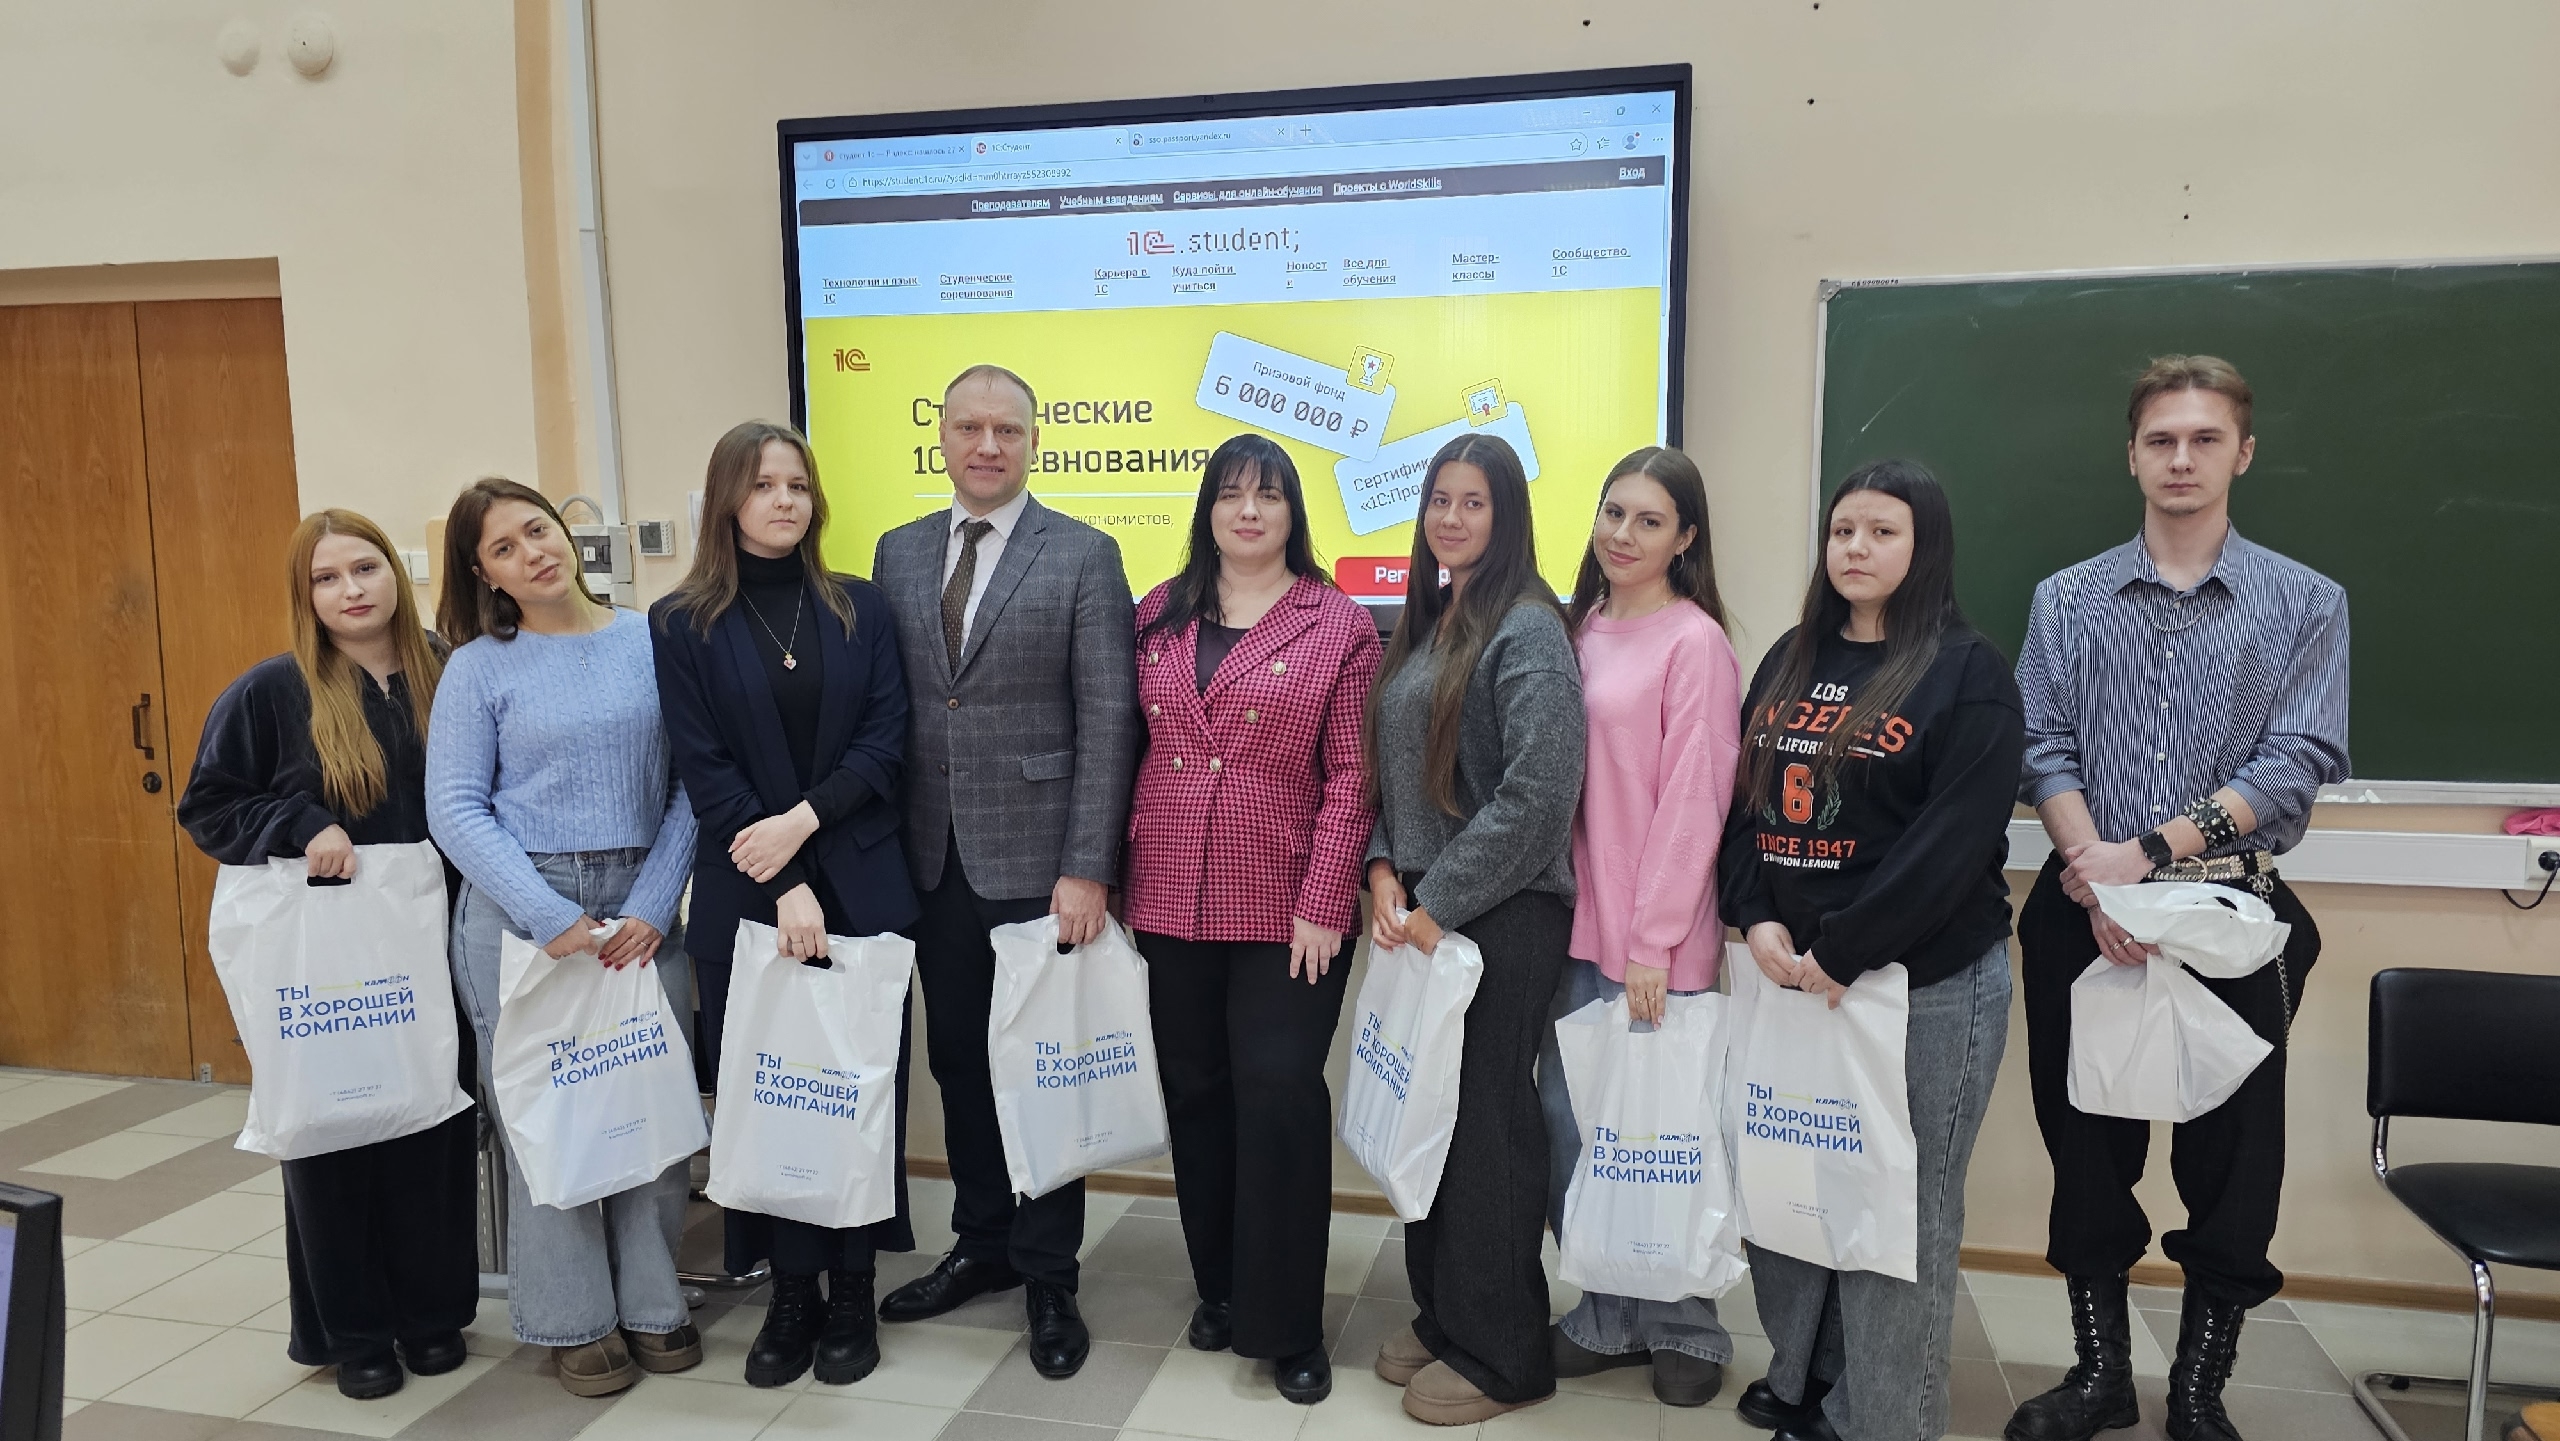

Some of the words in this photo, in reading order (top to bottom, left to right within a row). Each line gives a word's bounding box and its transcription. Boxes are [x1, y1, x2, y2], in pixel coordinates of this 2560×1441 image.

[1619, 167, 1646, 180] Вход
[1173, 190, 1216, 203] Сервисы
[1219, 188, 1236, 202] для
[1239, 185, 1323, 199] онлайн-обучения
[1333, 182, 1378, 195] Проекты
[1389, 176, 1442, 191] WorldSkills
[972, 198, 1051, 212] Преподавателям
[1060, 195, 1103, 208] Учебным
[1105, 193, 1164, 206] заведениям
[1452, 252, 1500, 265] Мастер-
[1552, 247, 1628, 260] Сообщество
[1172, 266, 1198, 277] Куда
[1201, 264, 1234, 275] пойти
[1287, 260, 1328, 271] Новост
[1343, 258, 1364, 269] Все
[1366, 258, 1388, 269] для
[1552, 265, 1568, 277] 1С
[823, 278, 880, 289] Технологии
[891, 276, 918, 287] язык
[940, 273, 1013, 285] Студенческие
[1094, 268, 1138, 280] Карьера
[1343, 274, 1396, 287] обучения
[1452, 269, 1495, 281] классы
[940, 289, 1013, 300] соревнования
[1095, 284, 1109, 295] 1С
[1172, 282, 1217, 293] учиться
[823, 293, 836, 304] 1С
[1253, 361, 1312, 389] Призовой
[1314, 381, 1347, 402] фонд
[912, 397, 1153, 427] Стческие
[1215, 374, 1232, 396] 6
[1238, 382, 1287, 413] 000
[1294, 401, 1343, 432] 000
[913, 446, 1210, 475] 1Свнования
[1353, 456, 1434, 492] Сертифик
[1360, 484, 1423, 512] «1С:Про
[1811, 682, 1849, 702] LOS
[1783, 762, 1815, 825] 6
[1807, 839, 1856, 858] 1947
[1802, 858, 1841, 870] LEAGUE
[276, 985, 310, 1002] ТЫ
[279, 1006, 293, 1021] В
[300, 986, 414, 1019] ХОРОШЕЙ
[280, 1007, 416, 1040] КОМПАНИИ
[1368, 1011, 1382, 1034] ТЫ
[1361, 1027, 1371, 1042] В
[547, 1036, 576, 1056] ТЫ
[551, 1058, 563, 1072] В
[568, 1020, 664, 1066] ХОРОШЕЙ
[1035, 1041, 1061, 1055] ТЫ
[552, 1041, 668, 1089] КОМПАНИИ
[756, 1052, 782, 1070] ТЫ
[1036, 1059, 1047, 1072] В
[1052, 1041, 1136, 1072] ХОРОШЕЙ
[1037, 1060, 1137, 1089] КОМПАНИИ
[1356, 1043, 1407, 1105] КОМПАНИИ
[755, 1070, 766, 1085] В
[770, 1073, 859, 1104] ХОРОШЕЙ
[1747, 1082, 1772, 1101] ТЫ
[754, 1088, 857, 1121] КОМПАНИИ
[1747, 1102, 1757, 1117] В
[1763, 1104, 1861, 1135] ХОРОШЕЙ
[1595, 1126, 1620, 1143] ТЫ
[1746, 1121, 1863, 1154] КОМПАНИИ
[1593, 1145, 1606, 1160] В
[1593, 1164, 1702, 1185] КОМПАНИИ
